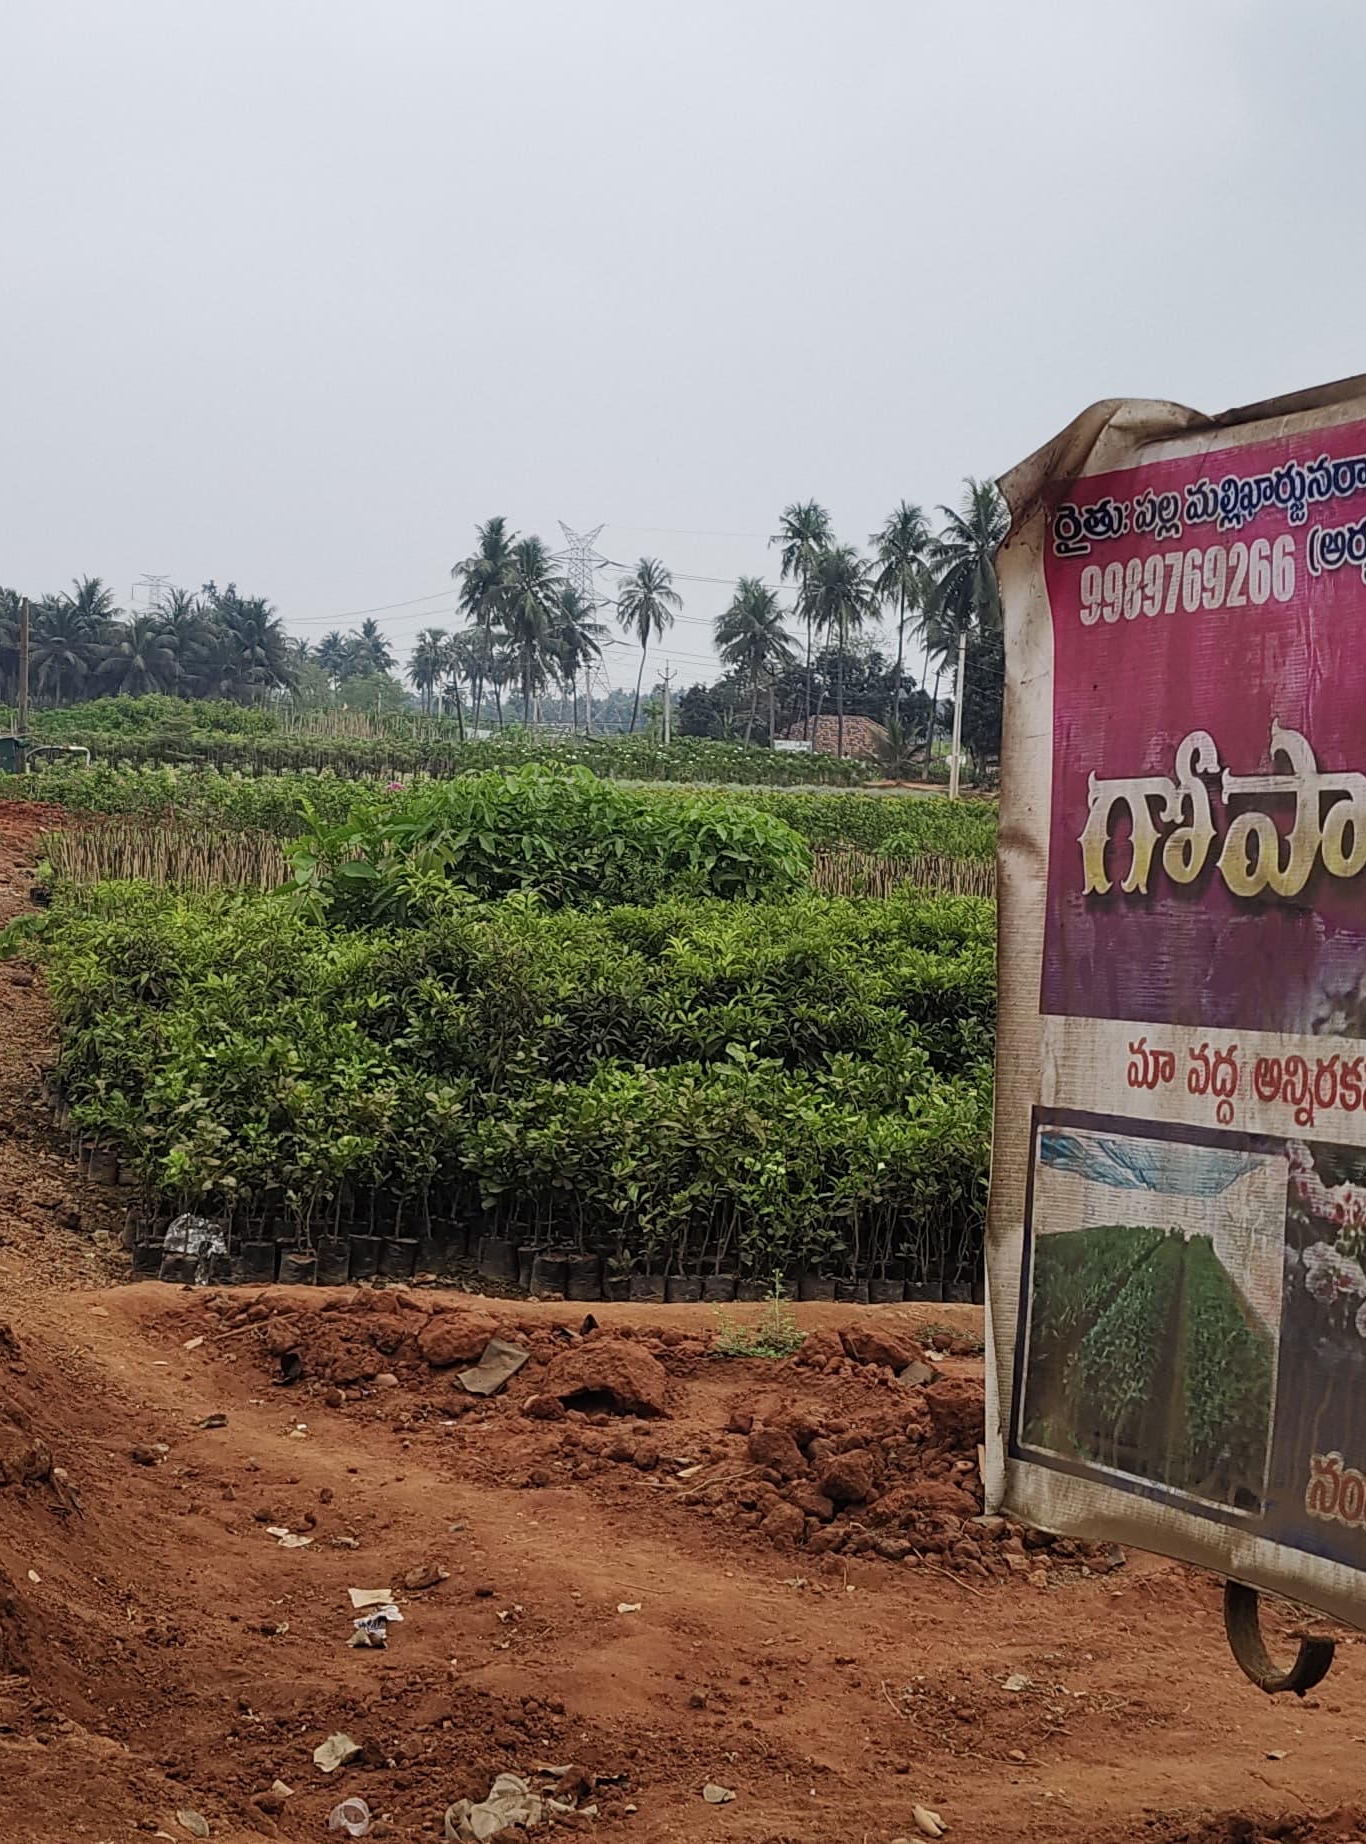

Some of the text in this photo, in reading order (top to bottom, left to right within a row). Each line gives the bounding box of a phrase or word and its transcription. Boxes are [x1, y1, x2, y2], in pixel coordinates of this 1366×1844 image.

[1053, 501, 1129, 557] రైతు:
[1134, 489, 1182, 540] పల్ల
[1080, 535, 1295, 626] 9989769266
[1127, 1037, 1176, 1090] మా
[1187, 1042, 1237, 1125] వద్ద
